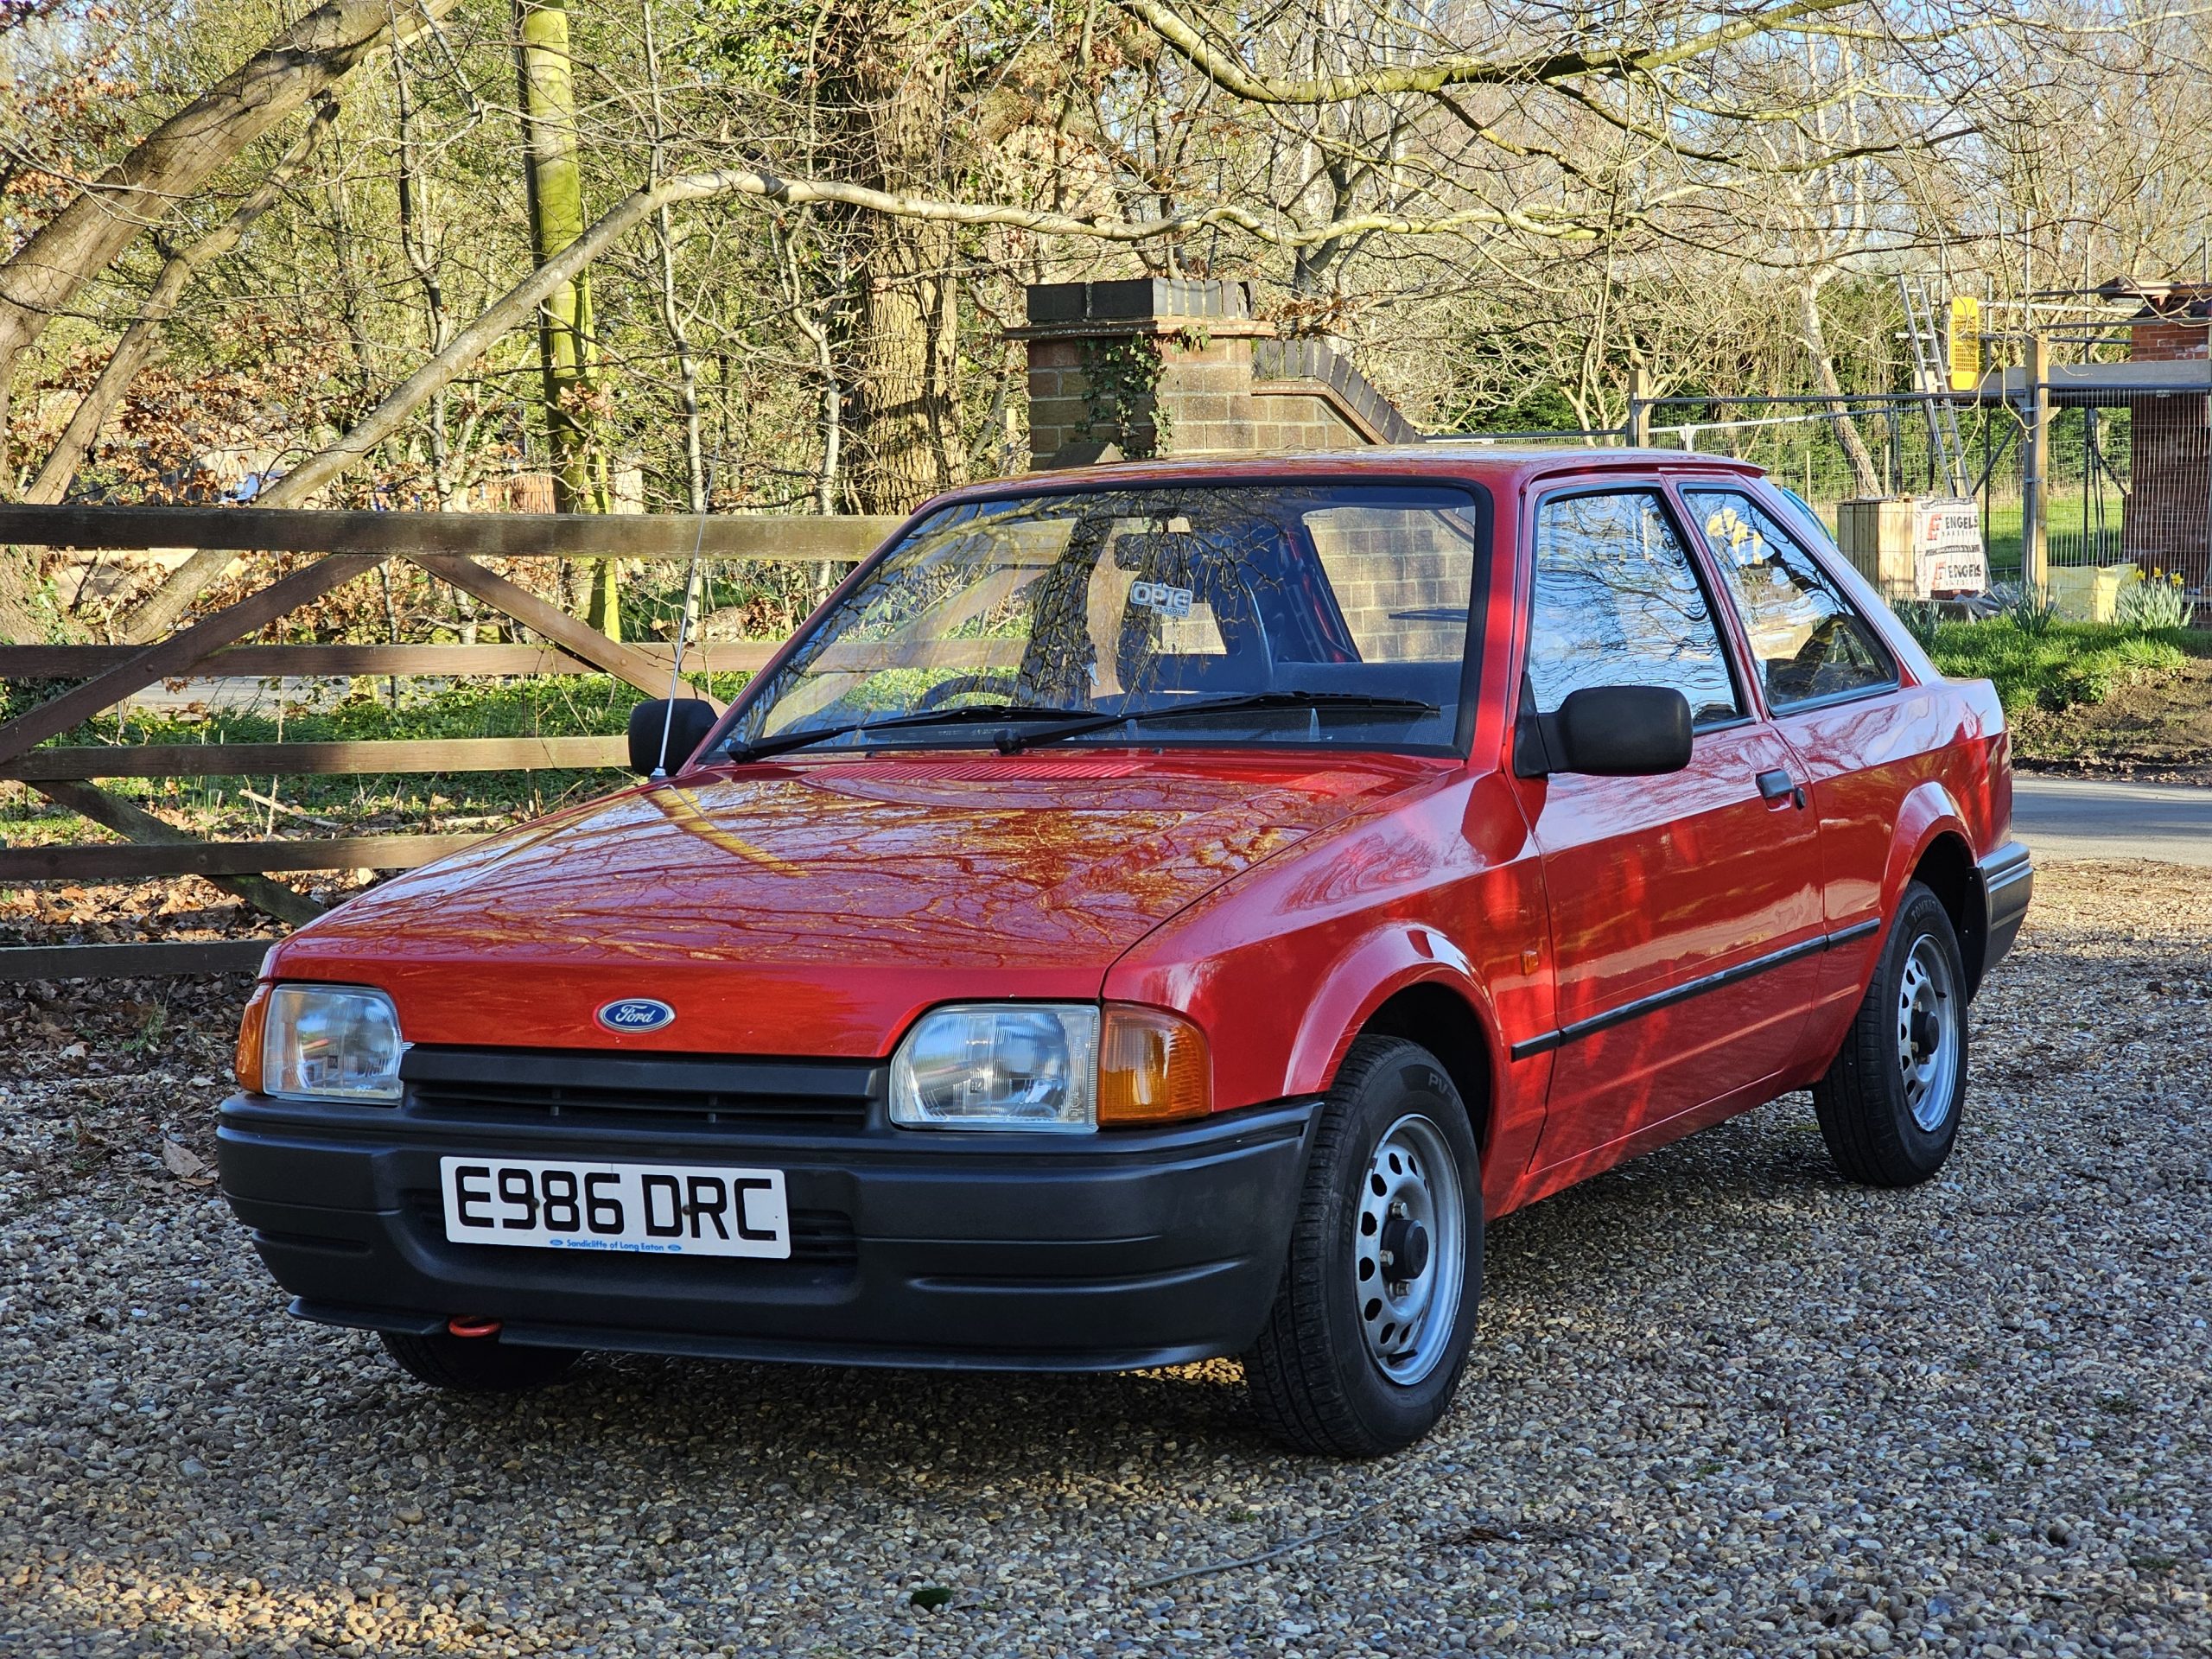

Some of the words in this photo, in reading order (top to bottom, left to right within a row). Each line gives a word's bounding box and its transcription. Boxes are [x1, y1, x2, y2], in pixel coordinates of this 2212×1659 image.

[1945, 516, 1978, 530] ENGELS
[1948, 563, 1981, 578] ENGELS
[1132, 585, 1192, 609] OPIE
[615, 1004, 656, 1023] Ford
[454, 1166, 625, 1236] E986
[640, 1173, 779, 1242] DRC
[566, 1239, 607, 1249] Sandicliffe
[609, 1241, 618, 1249] of
[620, 1242, 639, 1252] Long
[641, 1243, 664, 1251] Eaton
